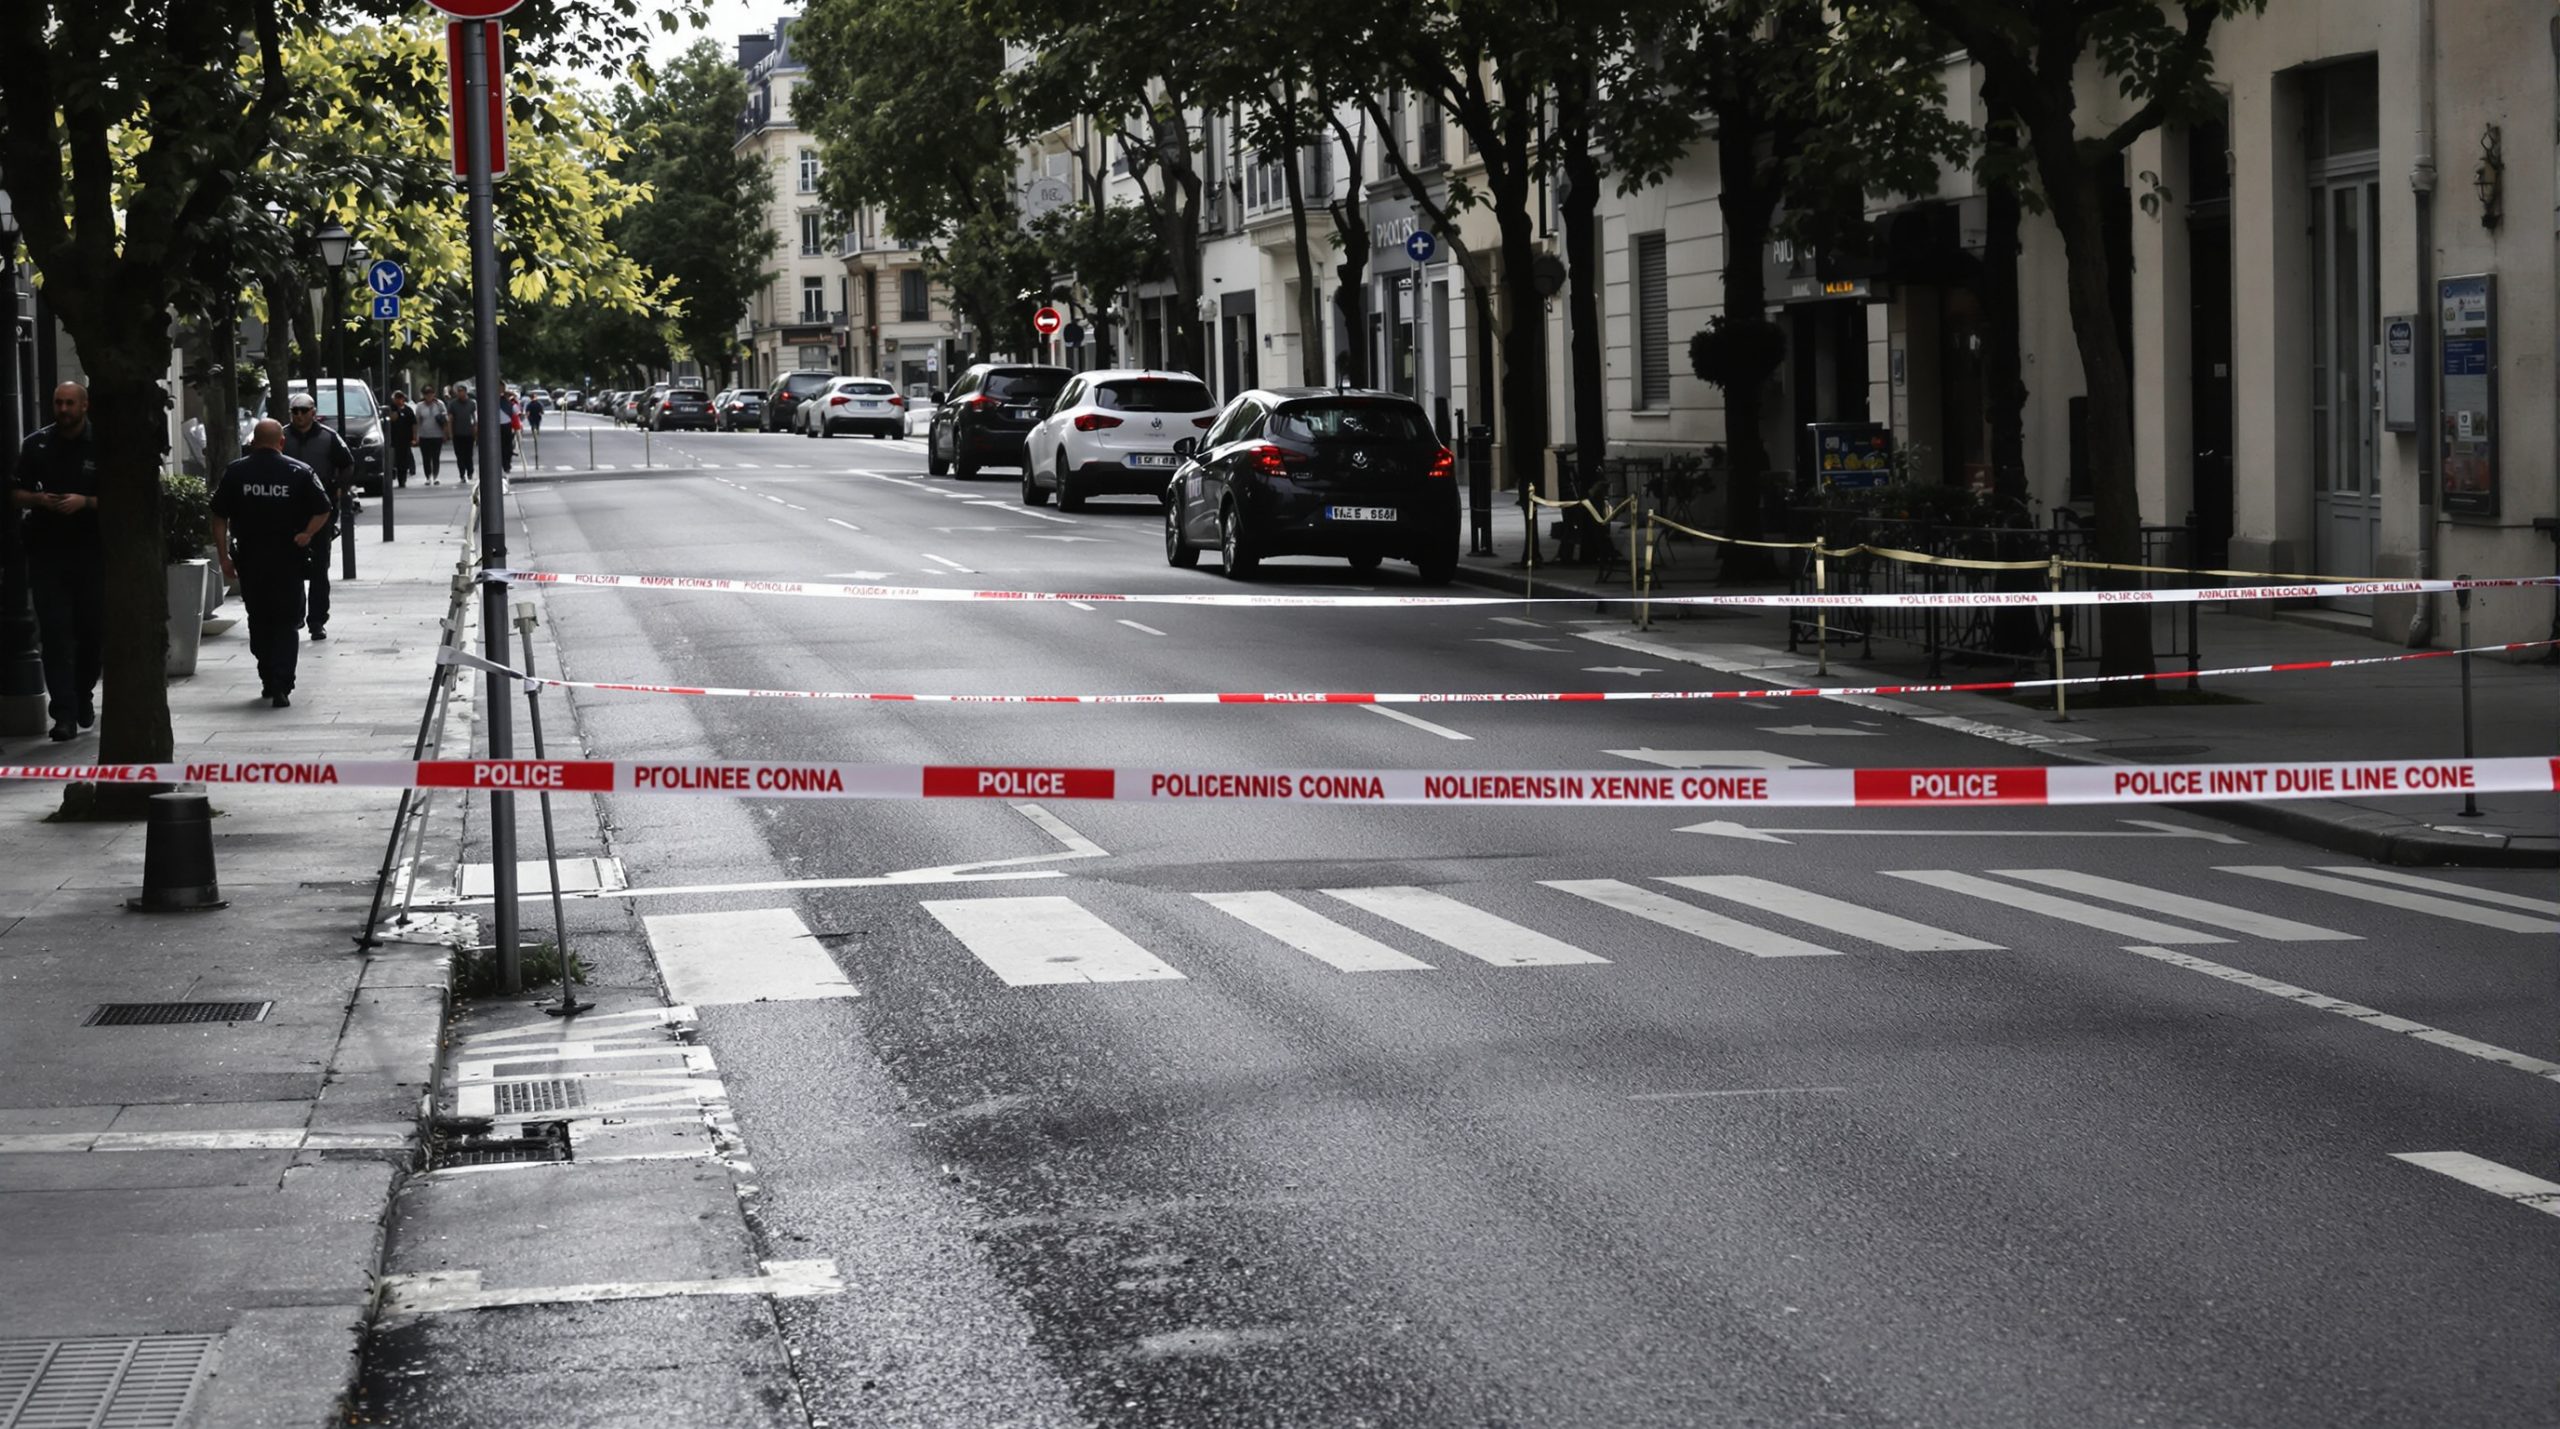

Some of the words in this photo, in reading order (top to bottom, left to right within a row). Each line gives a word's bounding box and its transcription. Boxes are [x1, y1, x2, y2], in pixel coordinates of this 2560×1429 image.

[243, 484, 290, 497] POLICE
[474, 764, 563, 786] POLICE
[756, 768, 843, 792] CONNA
[978, 772, 1065, 795] POLICE
[1151, 773, 1293, 798] POLICENNIS
[1299, 775, 1384, 799] CONNA
[1590, 776, 1673, 800] XENNE
[1681, 777, 1767, 800] CONEE
[1910, 774, 1998, 798] POLICE
[2114, 770, 2203, 795] POLICE
[2341, 767, 2399, 792] LINE
[2405, 765, 2475, 790] CONE
